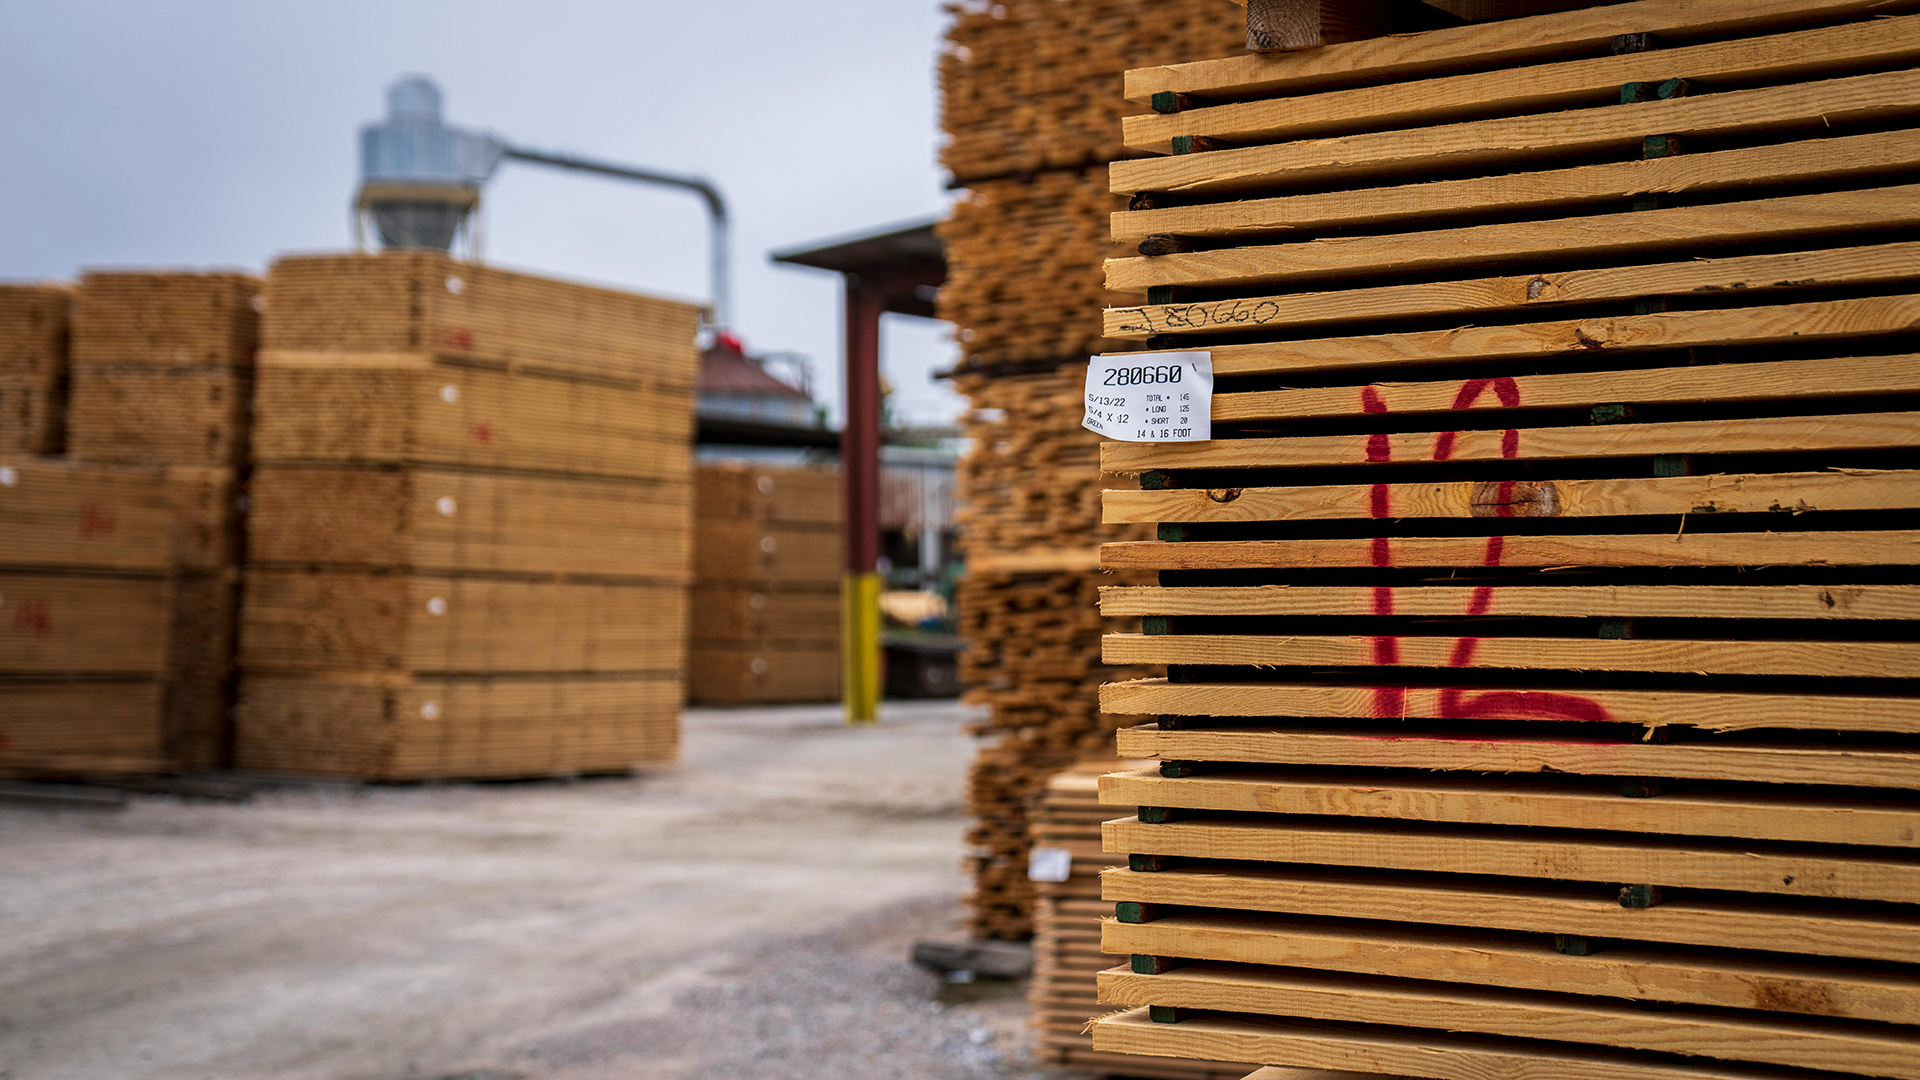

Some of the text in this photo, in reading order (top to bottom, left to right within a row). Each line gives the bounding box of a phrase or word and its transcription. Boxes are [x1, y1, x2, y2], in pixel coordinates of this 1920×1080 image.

[1103, 365, 1182, 386] 280660
[1088, 393, 1126, 407] 5/13/22
[1146, 393, 1190, 402] TOTAL 145
[1151, 404, 1190, 413] LONG 125
[1088, 405, 1102, 418] 5/4
[1117, 413, 1130, 424] 12
[1151, 416, 1188, 425] SHORT 20
[1137, 428, 1192, 438] 14 & 16 FOOT
